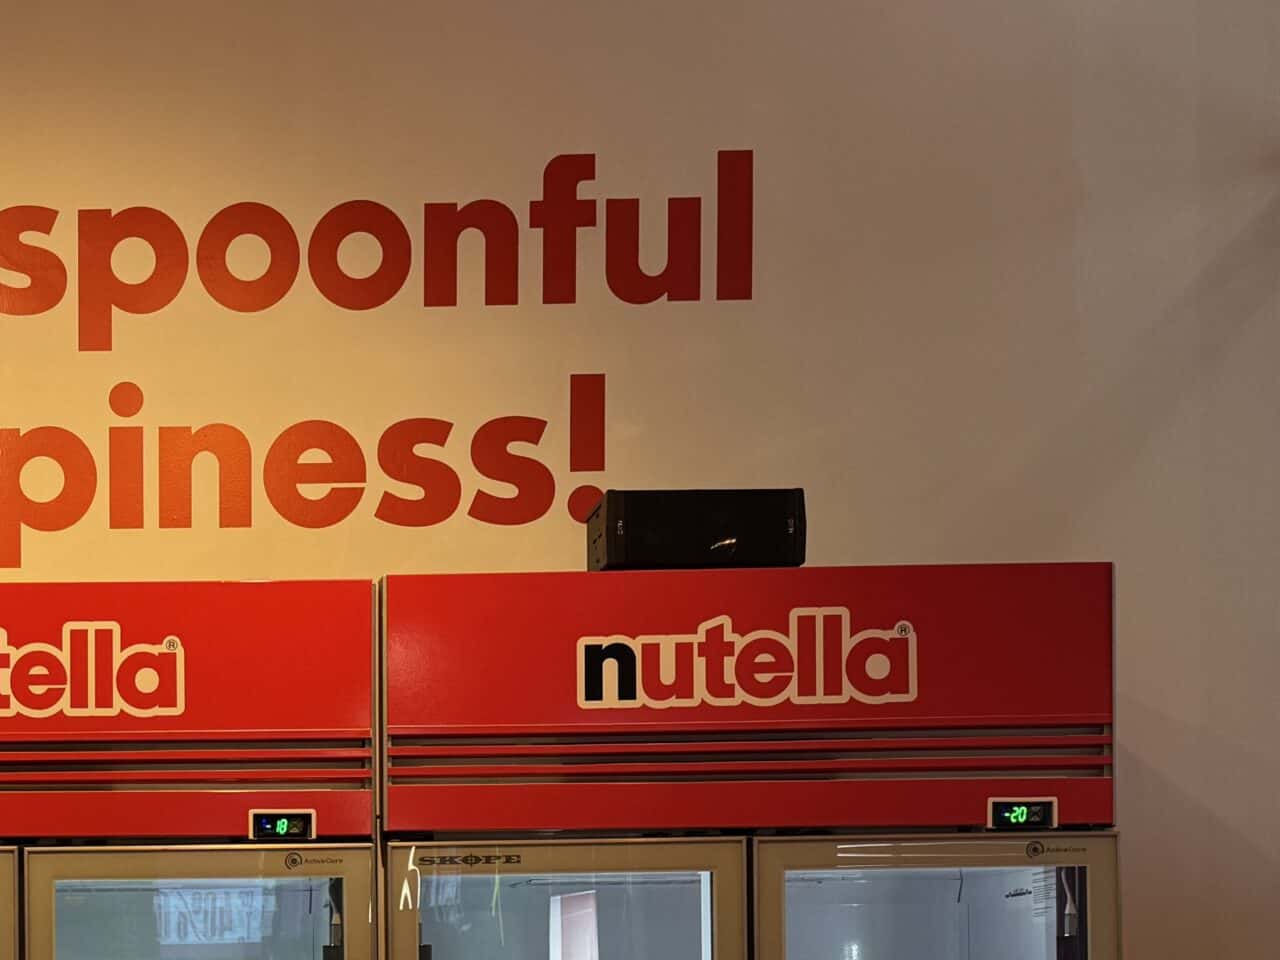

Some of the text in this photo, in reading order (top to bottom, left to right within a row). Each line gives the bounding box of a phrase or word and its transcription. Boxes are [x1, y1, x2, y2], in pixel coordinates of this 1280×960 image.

[583, 613, 911, 701] nutella
[1004, 806, 1027, 823] -20
[418, 853, 521, 867] SKOPE
